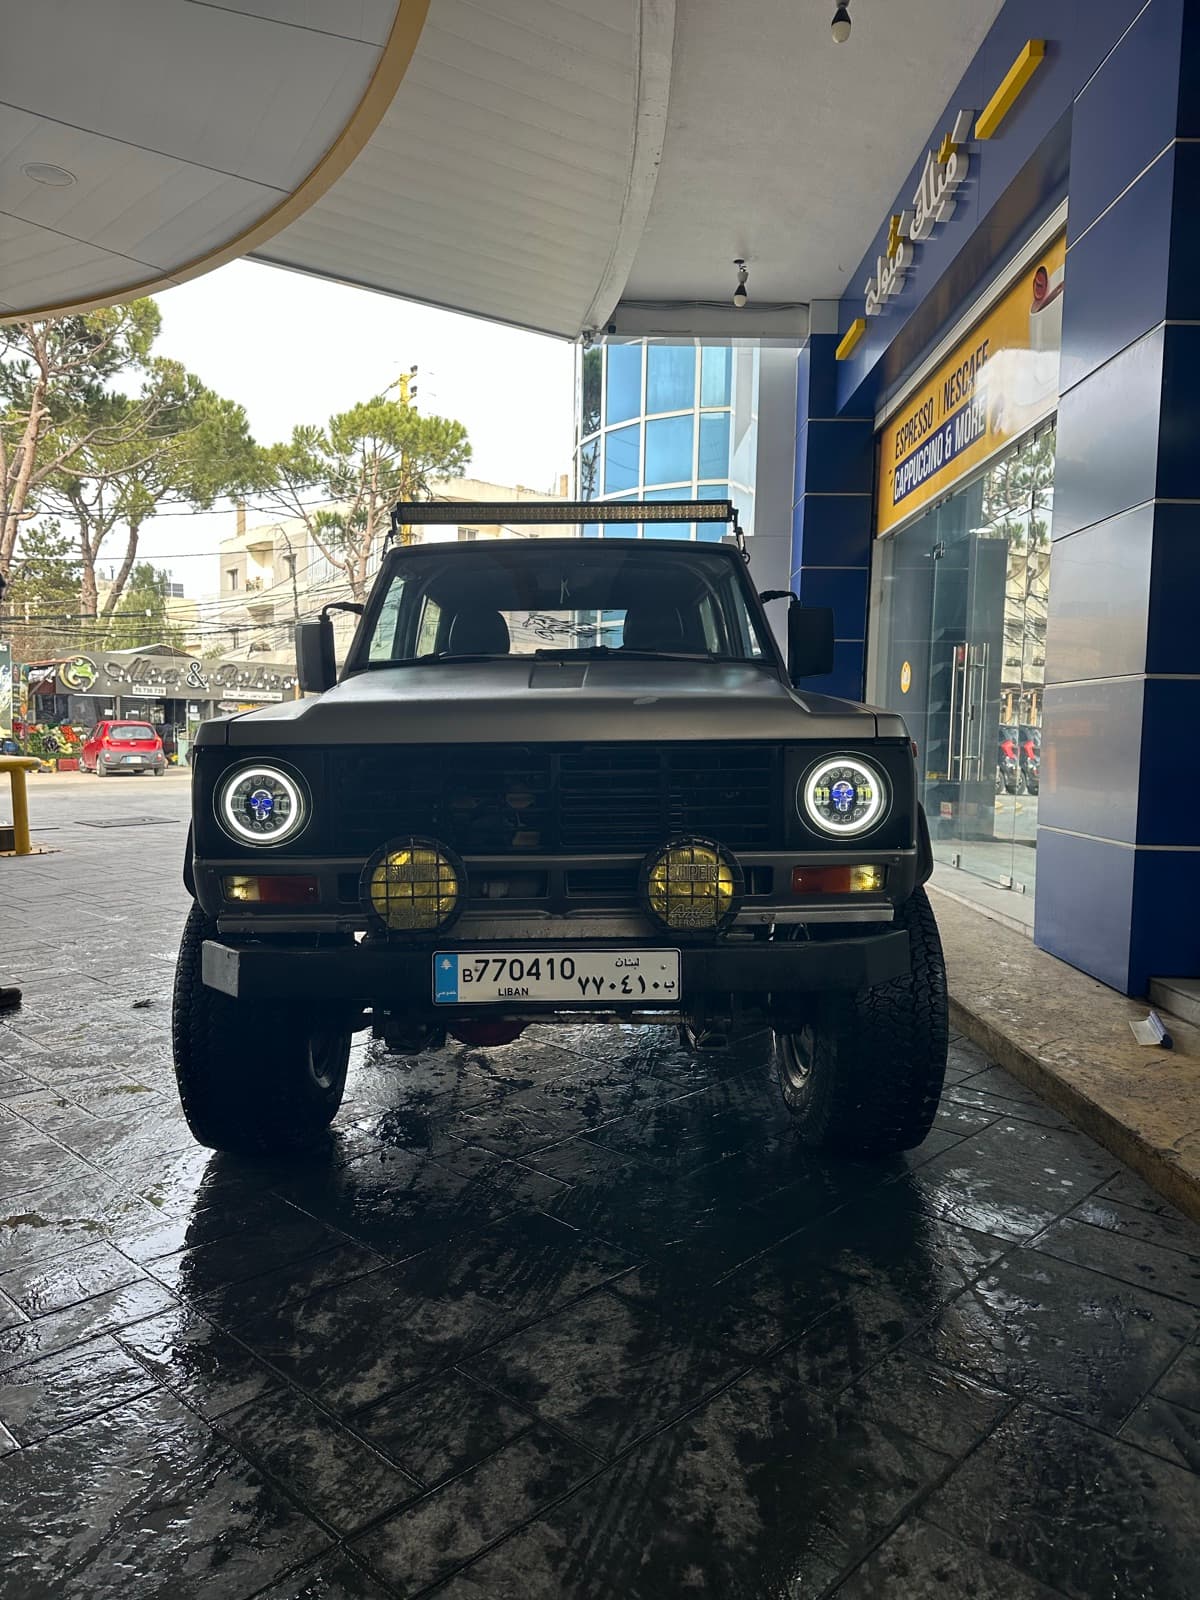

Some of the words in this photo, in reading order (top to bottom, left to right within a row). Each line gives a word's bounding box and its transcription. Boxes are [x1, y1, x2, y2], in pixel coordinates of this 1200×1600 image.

[895, 397, 933, 459] ESPRESSO
[894, 437, 943, 500] CAPPUCCINO
[944, 427, 952, 459] &
[955, 400, 985, 452] MORE
[186, 660, 209, 689] &
[668, 863, 719, 881] SUPER
[462, 968, 474, 983] B
[474, 957, 576, 982] 770410
[615, 957, 640, 970] لبنان
[498, 987, 529, 997] LIBAN
